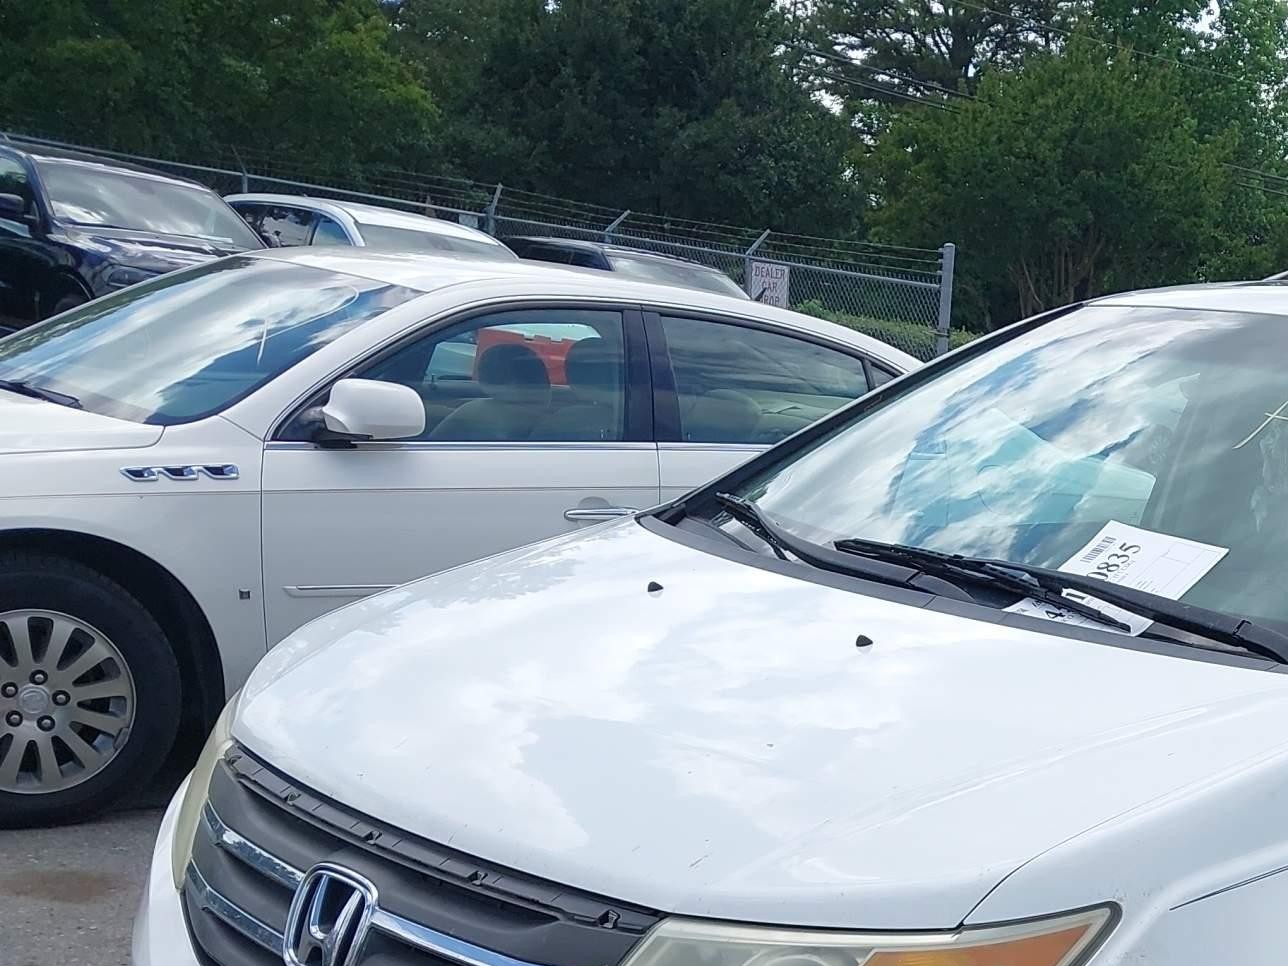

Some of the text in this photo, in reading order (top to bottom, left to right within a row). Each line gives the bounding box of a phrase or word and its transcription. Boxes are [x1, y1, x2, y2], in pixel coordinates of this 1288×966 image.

[755, 266, 786, 281] DEALER
[761, 281, 778, 293] CAR
[761, 295, 780, 305] ROP
